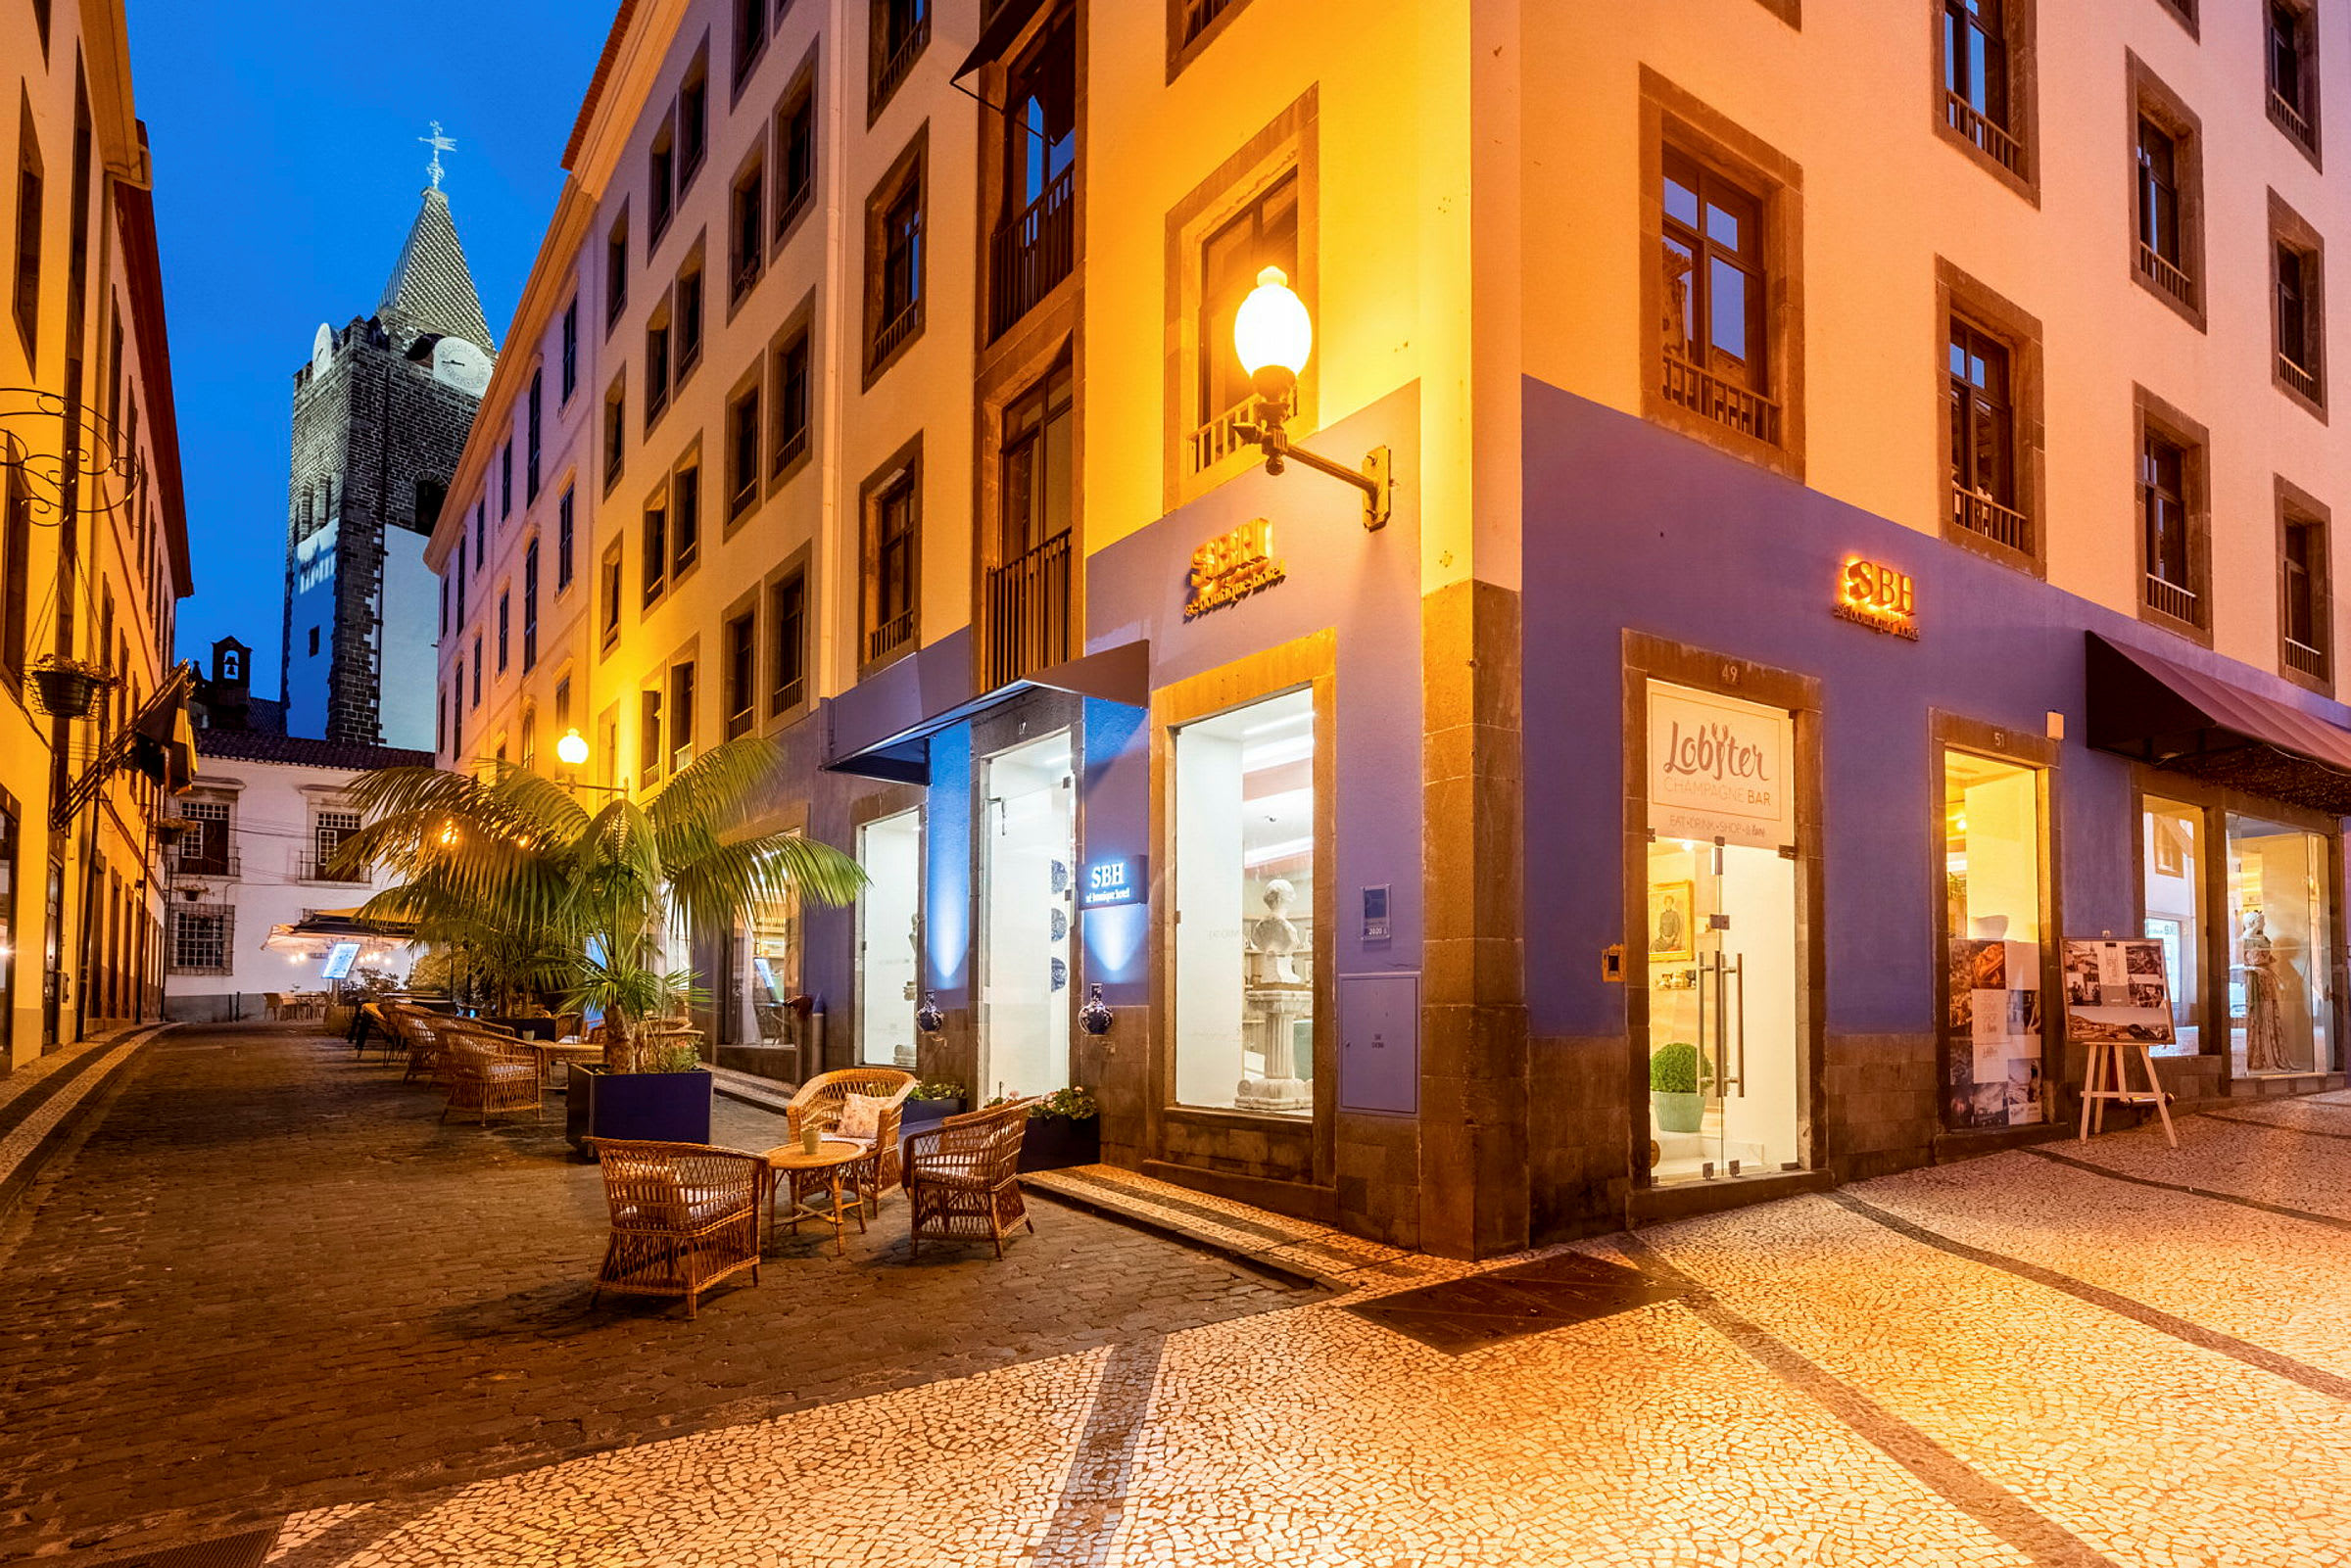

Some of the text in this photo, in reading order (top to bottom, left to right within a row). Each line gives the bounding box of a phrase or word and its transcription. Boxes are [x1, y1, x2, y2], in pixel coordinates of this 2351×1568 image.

[1847, 561, 1915, 616] SBH
[1721, 664, 1738, 683] 49
[1663, 721, 1770, 781] Lobster
[1994, 732, 2005, 746] 51
[1664, 776, 1771, 806] CHAMPAGNE BAR
[1091, 862, 1125, 888] SBH
